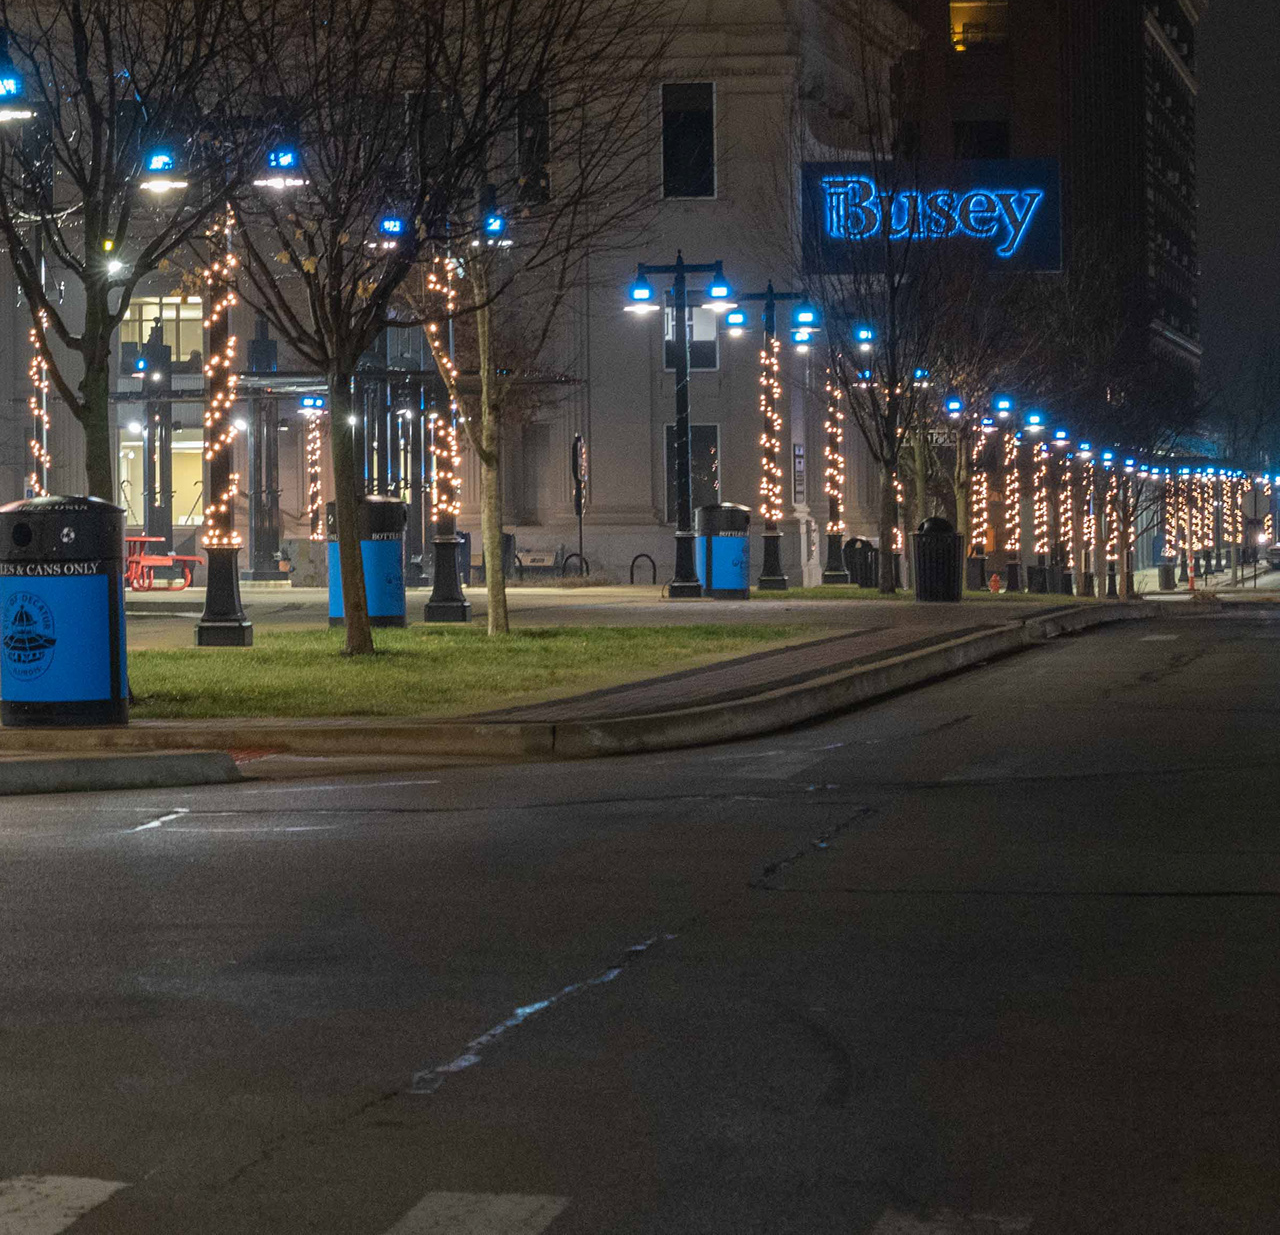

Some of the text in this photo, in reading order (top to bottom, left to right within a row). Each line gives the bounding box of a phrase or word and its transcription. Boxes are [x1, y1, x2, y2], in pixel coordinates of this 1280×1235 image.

[819, 176, 1044, 256] Busey
[16, 564, 24, 576] &
[26, 563, 61, 576] CANS
[63, 562, 98, 575] ONLY
